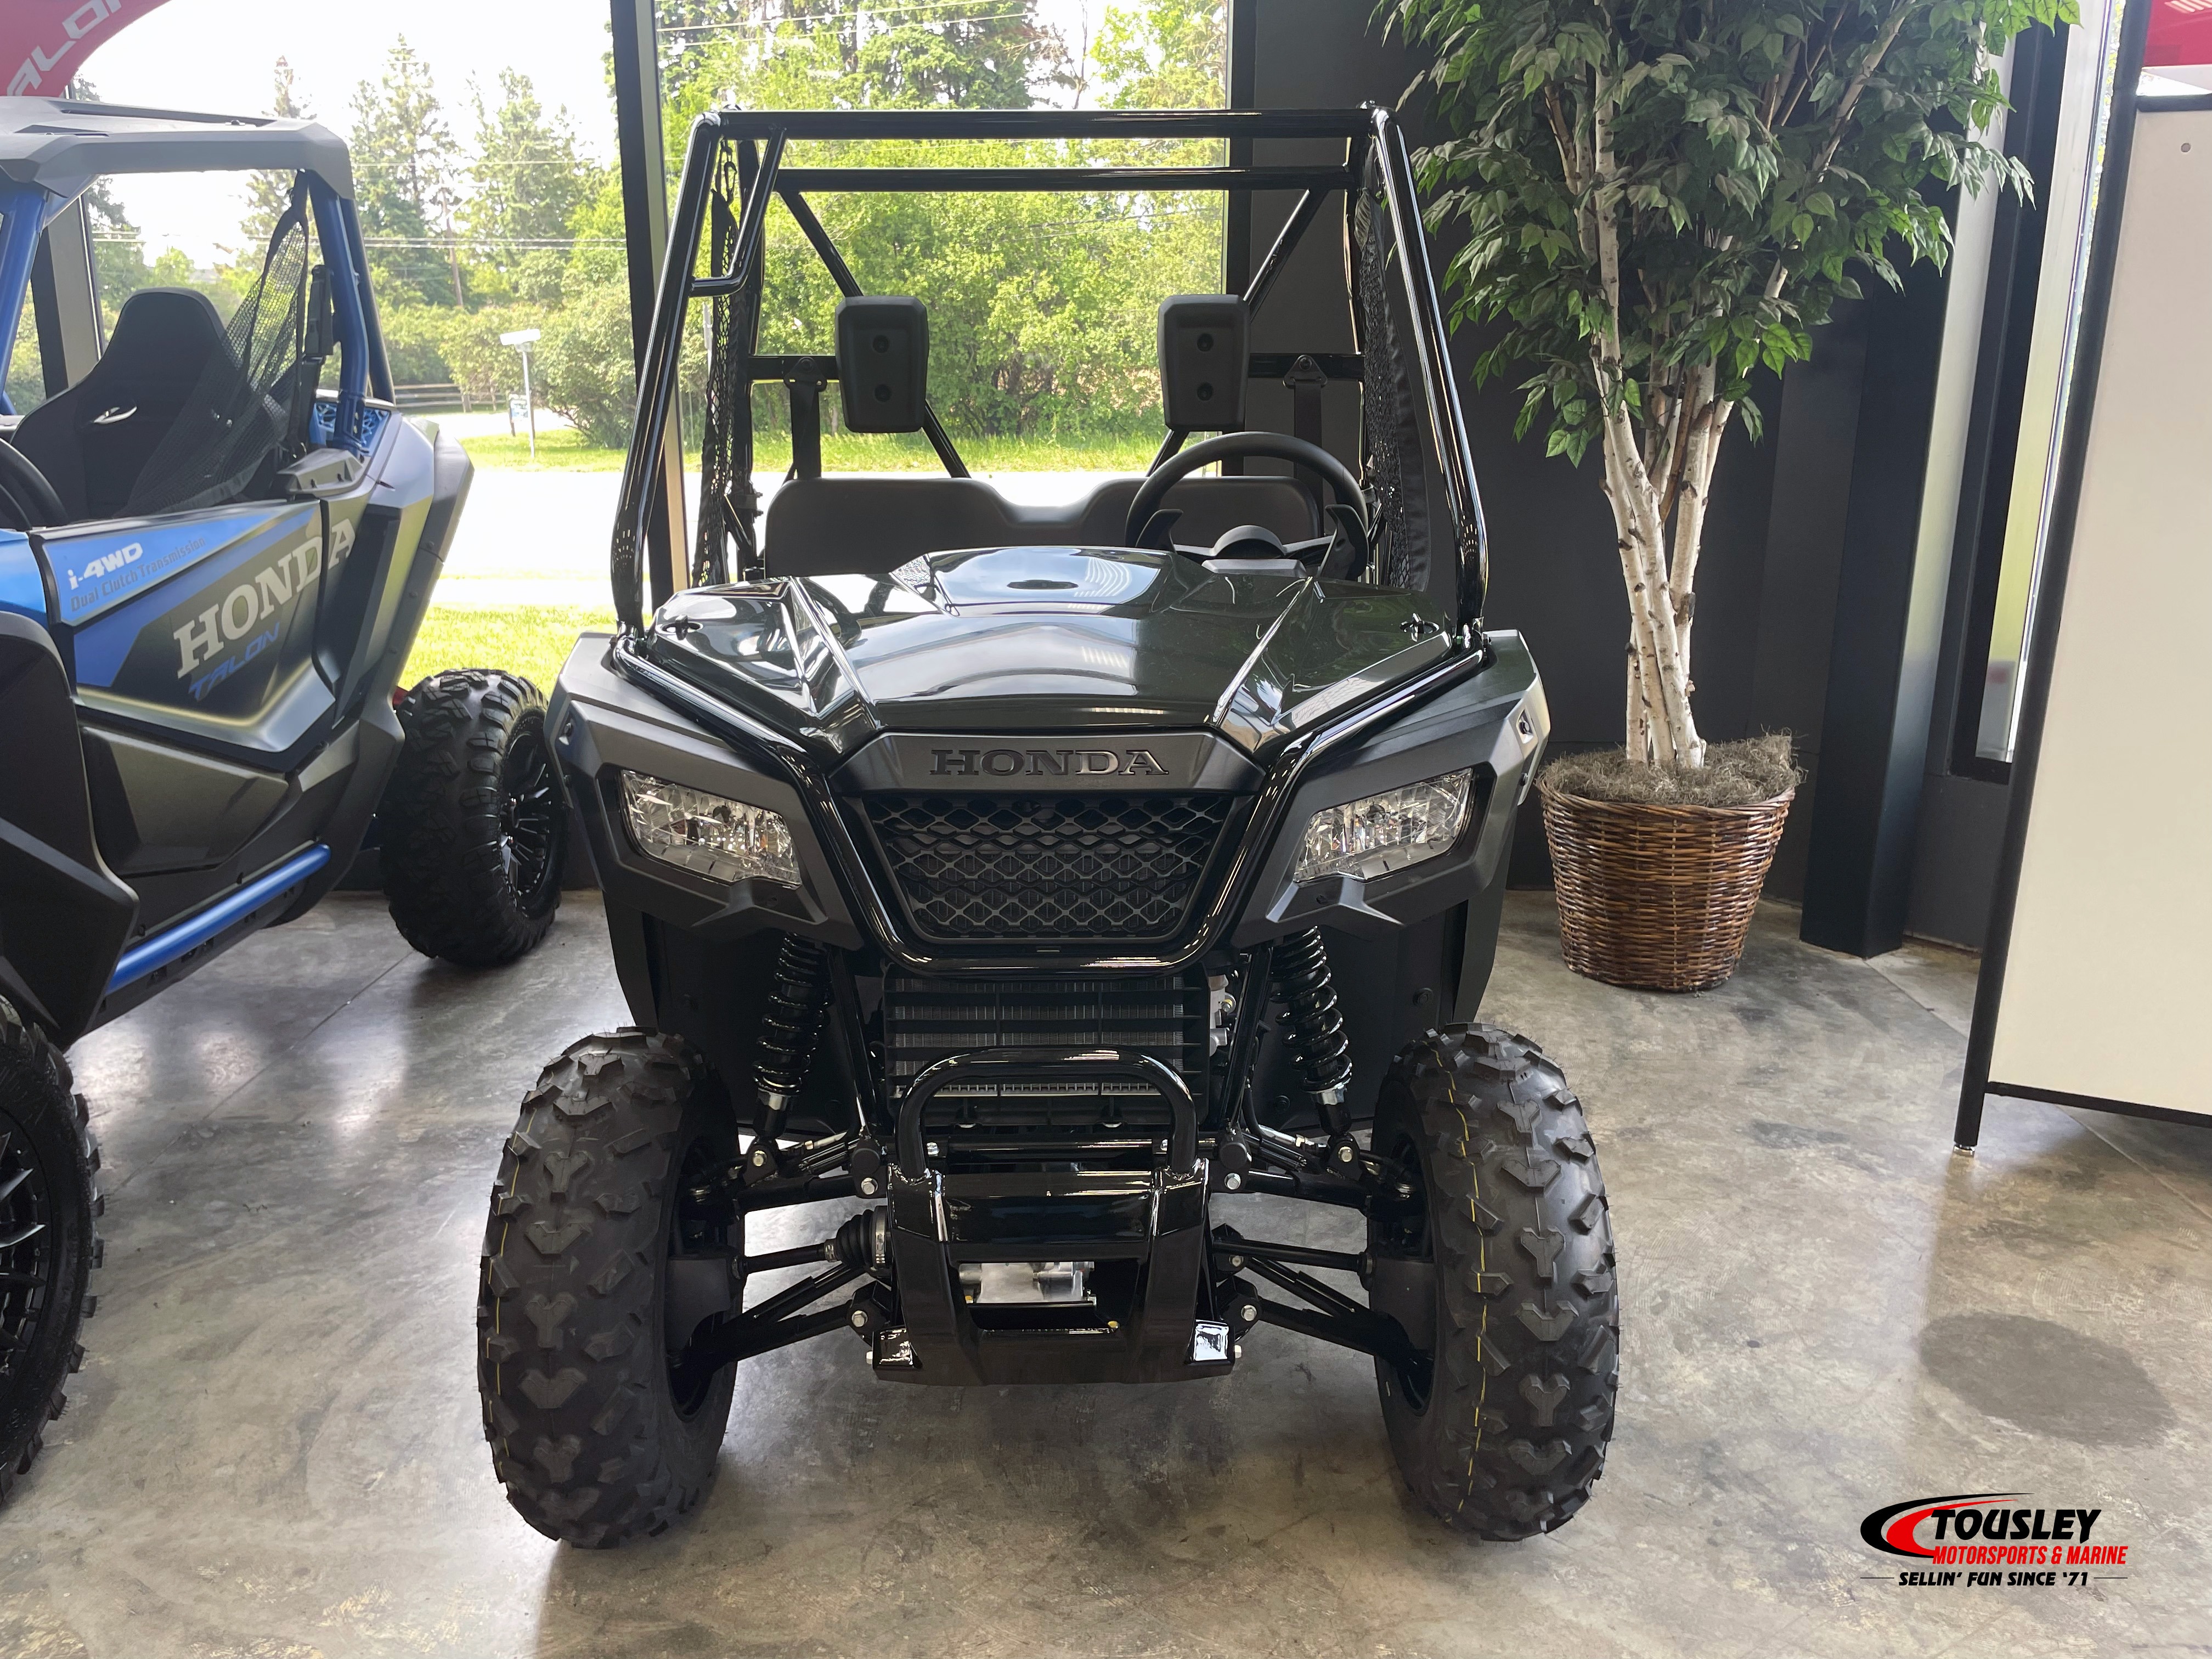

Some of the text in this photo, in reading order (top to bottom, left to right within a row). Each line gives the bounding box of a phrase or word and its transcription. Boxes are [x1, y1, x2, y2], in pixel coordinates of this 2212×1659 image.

[67, 542, 143, 590] i-4WD
[70, 537, 206, 612] Dual Clutch Transmission
[173, 518, 356, 679] HONDA
[188, 622, 280, 702] TALON
[929, 749, 1170, 776] HONDA
